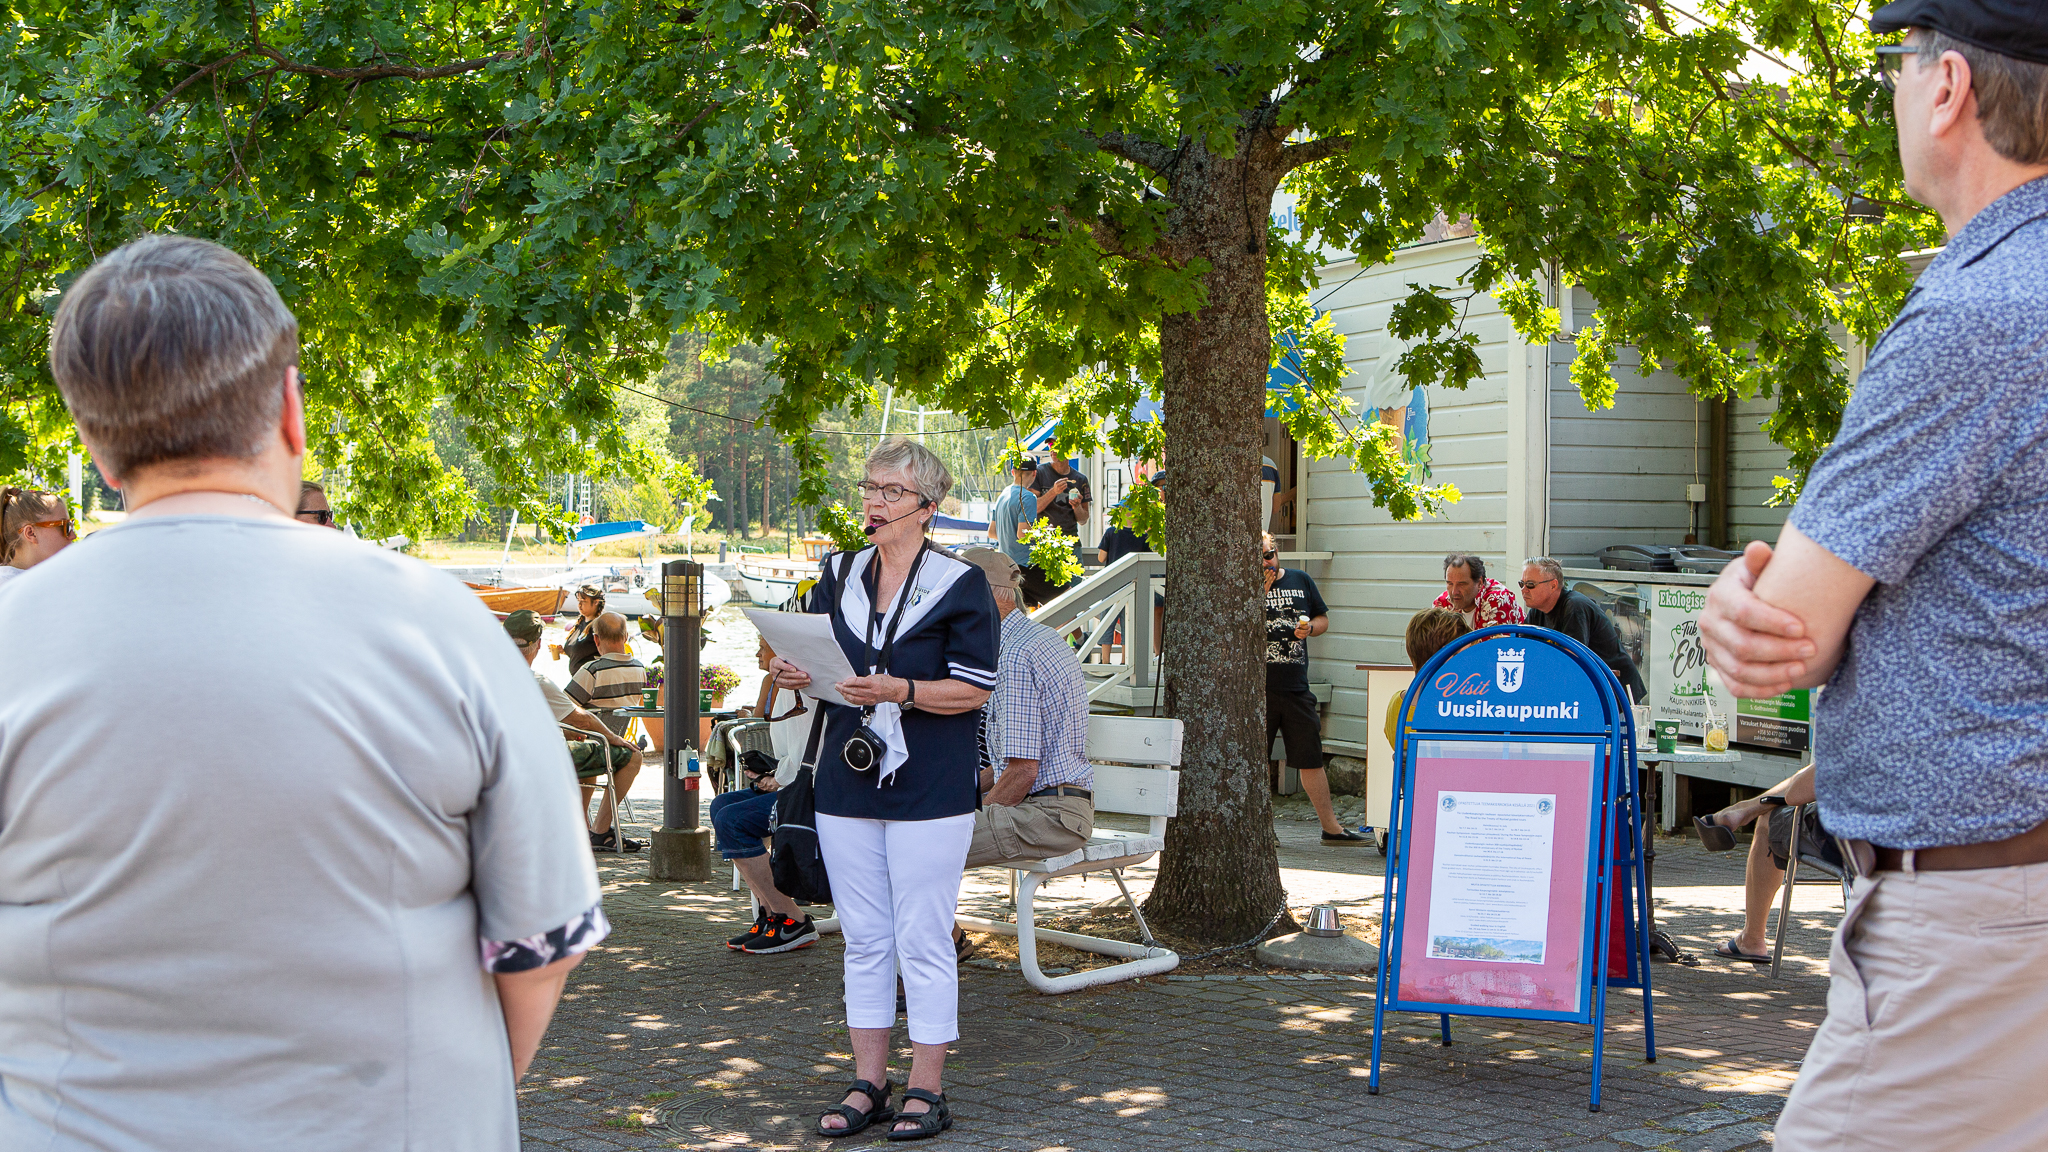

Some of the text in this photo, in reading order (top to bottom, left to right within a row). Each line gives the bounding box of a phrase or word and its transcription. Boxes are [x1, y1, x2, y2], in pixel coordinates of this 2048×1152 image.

[1266, 588, 1305, 599] ailman
[1659, 590, 1706, 613] Ekologise
[1435, 672, 1491, 698] Visit
[1438, 699, 1579, 722] Uusikaupunki
[1669, 695, 1718, 707] KAUPUNKIKIEROS
[1739, 719, 1806, 734] Varaukset Pakkahuoneen puodista
